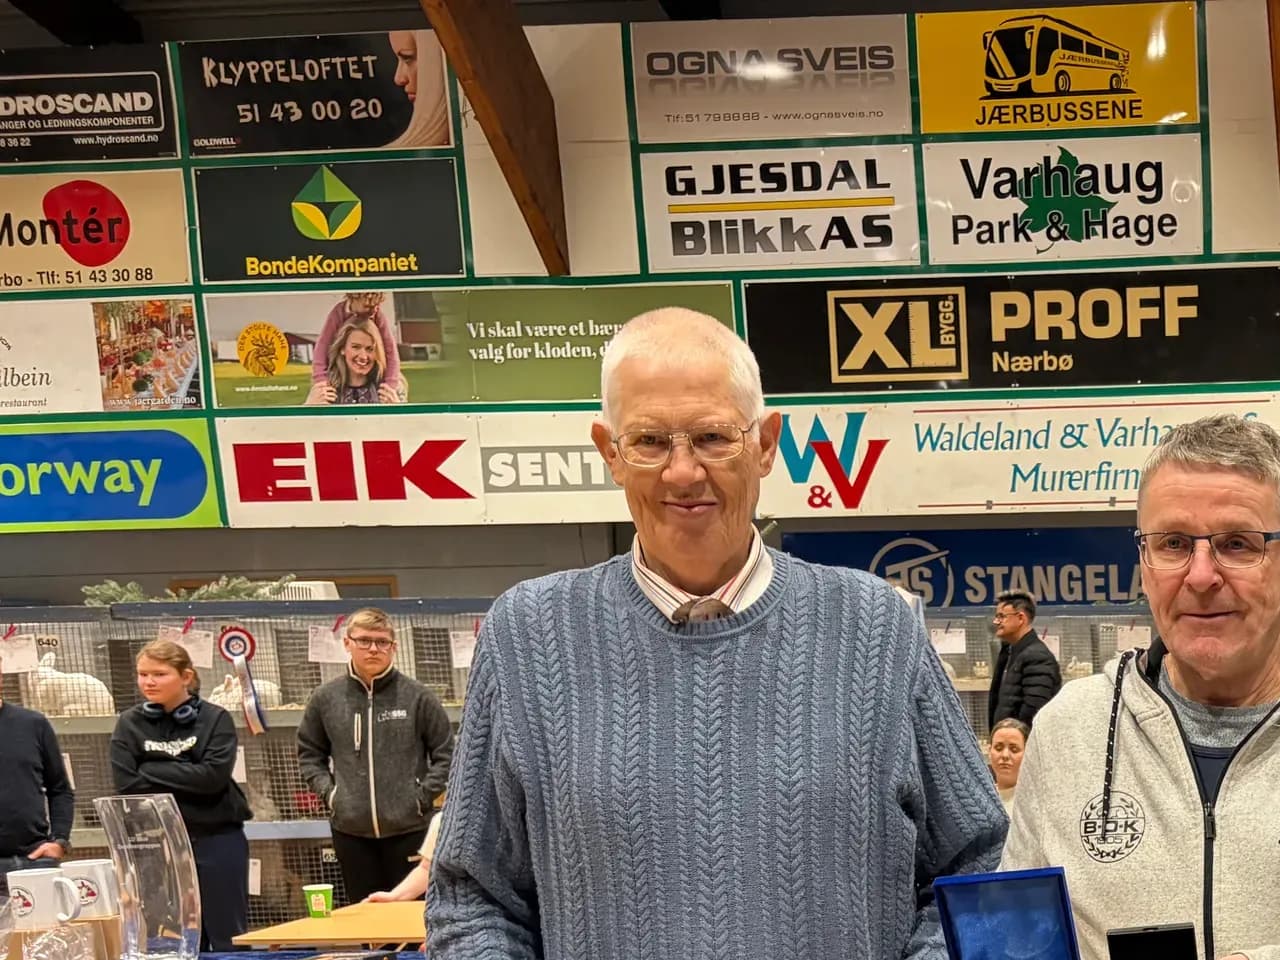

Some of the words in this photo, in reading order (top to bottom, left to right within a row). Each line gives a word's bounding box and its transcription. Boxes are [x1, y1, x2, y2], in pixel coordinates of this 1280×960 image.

[202, 55, 378, 88] KLYPPELOFTET
[777, 45, 895, 73] SVEIS
[0, 91, 154, 116] DROSCAND
[236, 103, 260, 123] 51
[270, 101, 303, 122] 43
[312, 100, 341, 121] 00
[350, 98, 383, 119] 20
[772, 109, 884, 121] www.ognasveis.no
[975, 99, 1143, 126] JÆRBUSSENE
[28, 119, 41, 129] OG
[43, 116, 154, 128] LEDNINGSKOMPONENTER
[20, 137, 31, 147] 22
[73, 134, 159, 146] www.hydroscand.no
[193, 137, 237, 147] GOLDWELL
[665, 158, 891, 197] GJESDAL
[959, 157, 1163, 203] Varhaug
[951, 213, 1032, 246] Park
[1045, 211, 1069, 241] &
[1082, 210, 1178, 245] Hage
[37, 270, 60, 285] Tlf:
[66, 270, 82, 284] 51
[89, 269, 107, 283] 43
[112, 268, 130, 282] 30
[135, 267, 153, 281] 88
[246, 254, 418, 276] BondeKompaniet
[990, 284, 1199, 343] PROFF
[467, 322, 485, 338] Vi
[488, 320, 522, 338] skal
[524, 323, 566, 338] være
[568, 322, 587, 336] et
[839, 300, 957, 370] XL
[469, 343, 505, 364] valg
[506, 342, 531, 359] for
[534, 341, 597, 360] kloden,
[992, 350, 1074, 373] Nærbø
[0, 367, 53, 387] lbein
[914, 420, 1052, 453] Waldeland
[1060, 423, 1088, 449] &
[232, 439, 477, 503] EIK
[488, 451, 607, 488] SENT
[0, 458, 162, 507] orway
